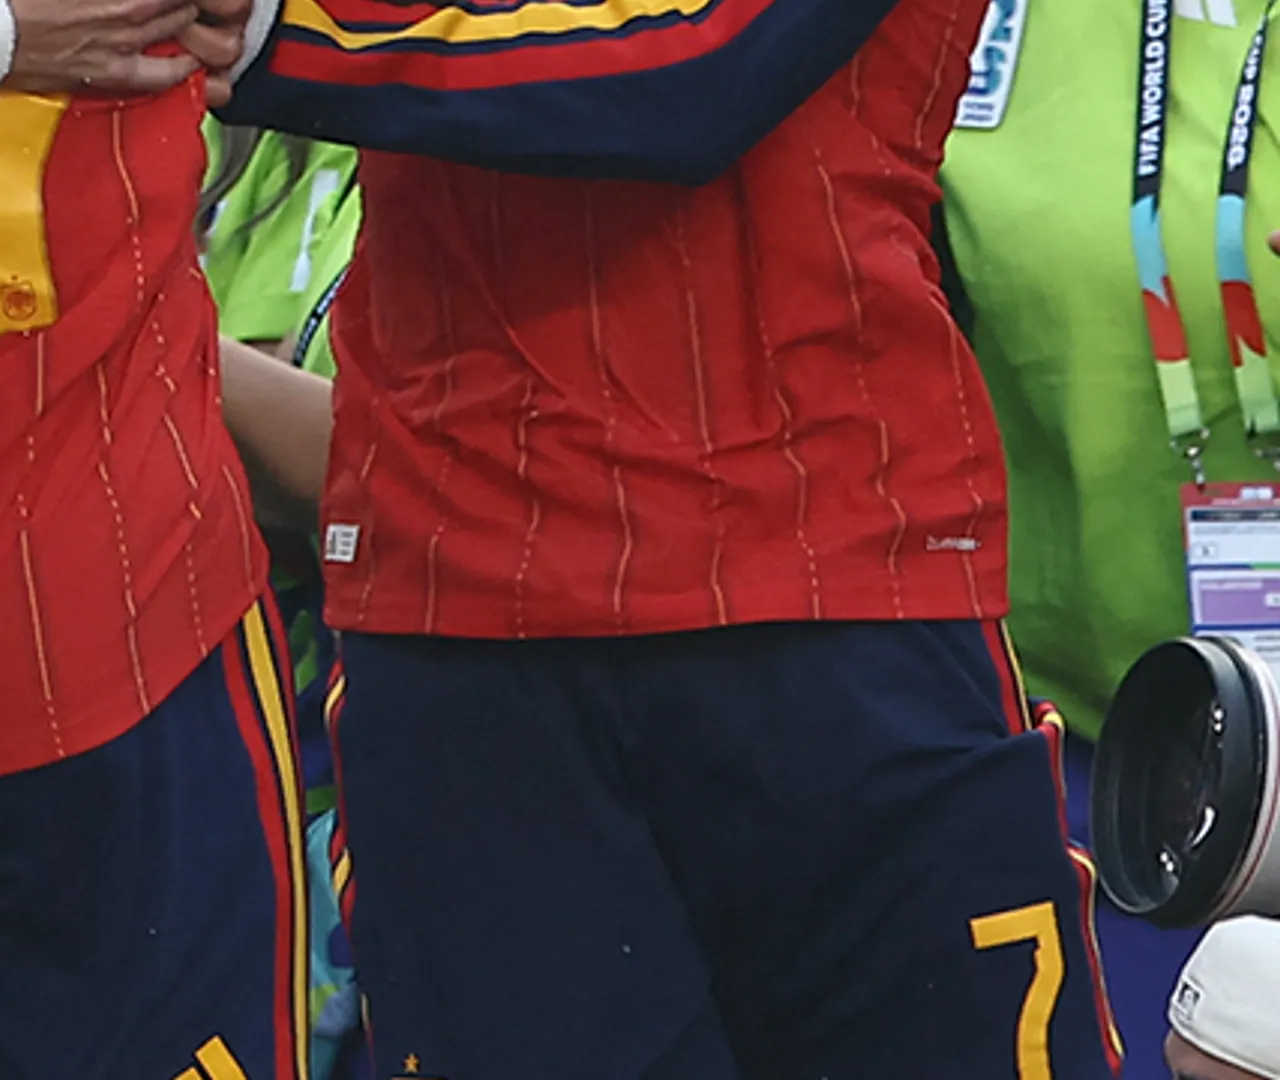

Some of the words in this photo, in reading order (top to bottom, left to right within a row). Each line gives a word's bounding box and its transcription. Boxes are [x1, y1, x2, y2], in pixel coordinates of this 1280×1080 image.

[1142, 40, 1165, 125] WORLD
[1138, 126, 1161, 176] FIFA
[970, 901, 1065, 1080] 7
